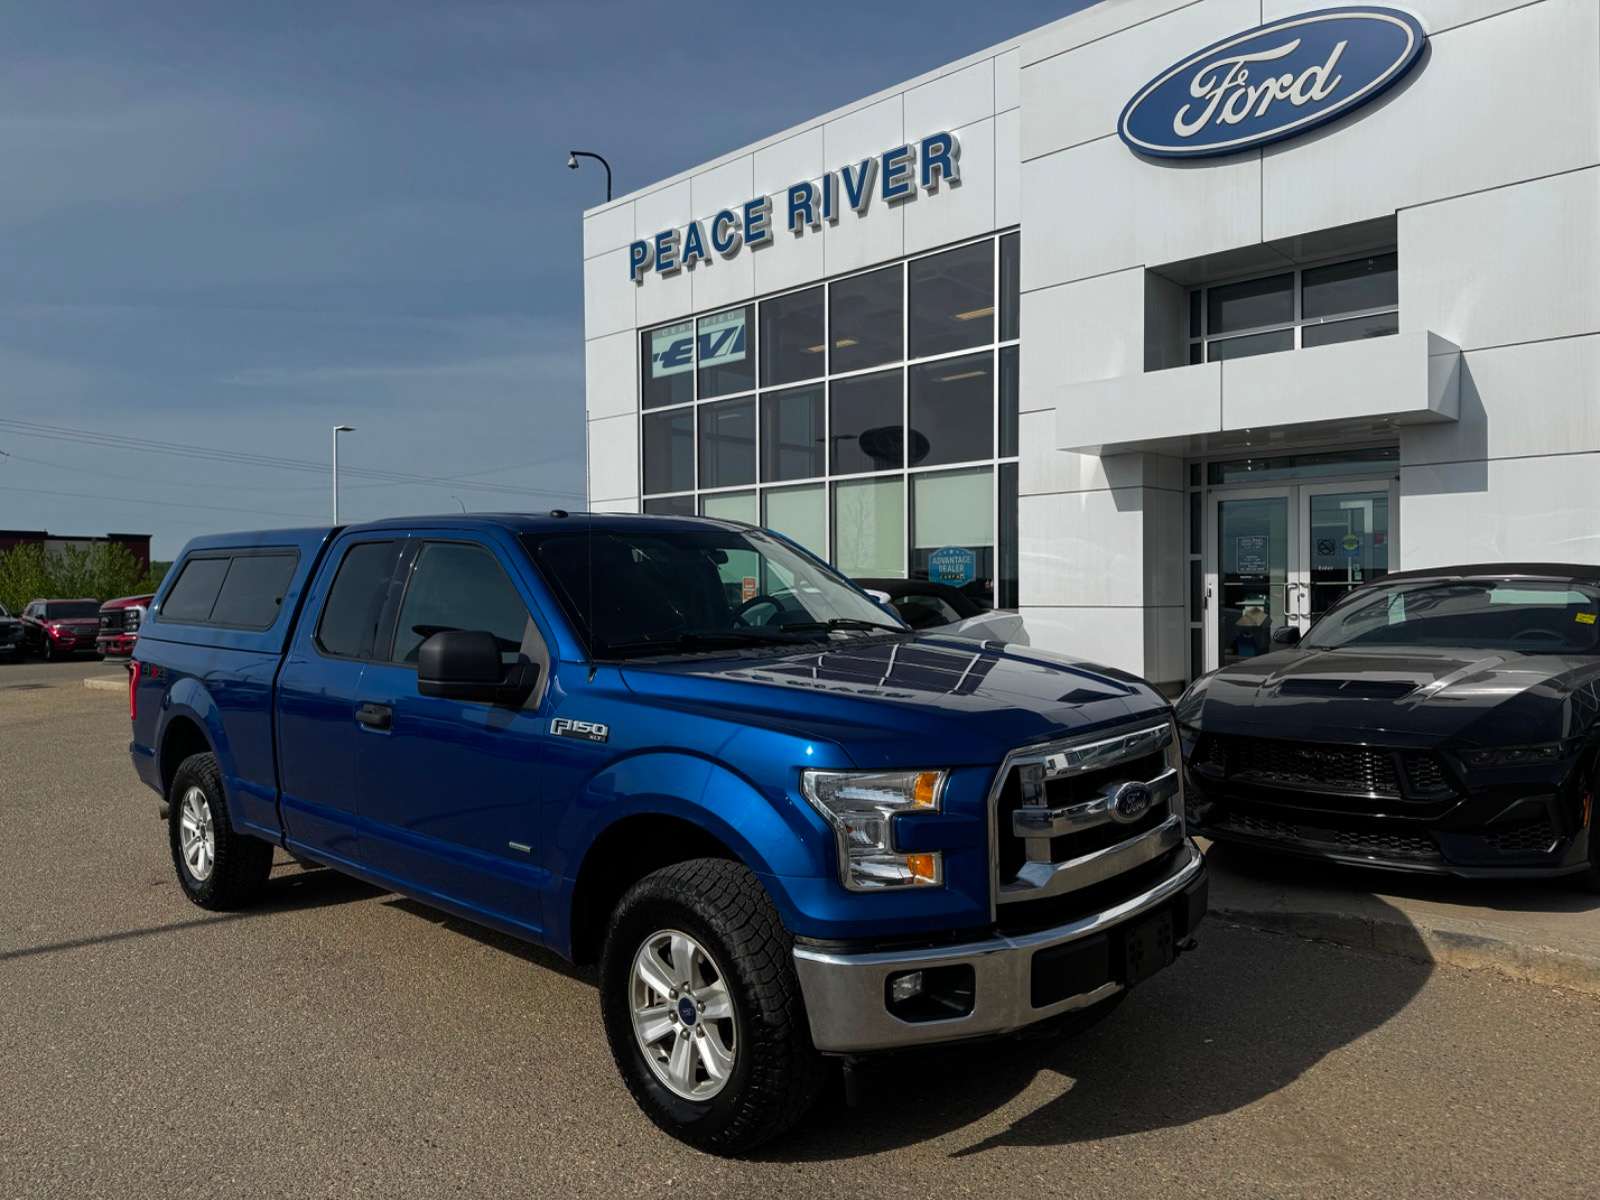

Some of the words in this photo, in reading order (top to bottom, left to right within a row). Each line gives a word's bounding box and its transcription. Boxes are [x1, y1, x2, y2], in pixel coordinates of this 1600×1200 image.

[1173, 38, 1349, 138] Ford
[629, 195, 771, 283] PEACE
[787, 131, 962, 233] RIVER
[932, 556, 972, 565] ADVANTAGE
[938, 564, 965, 573] DEALER
